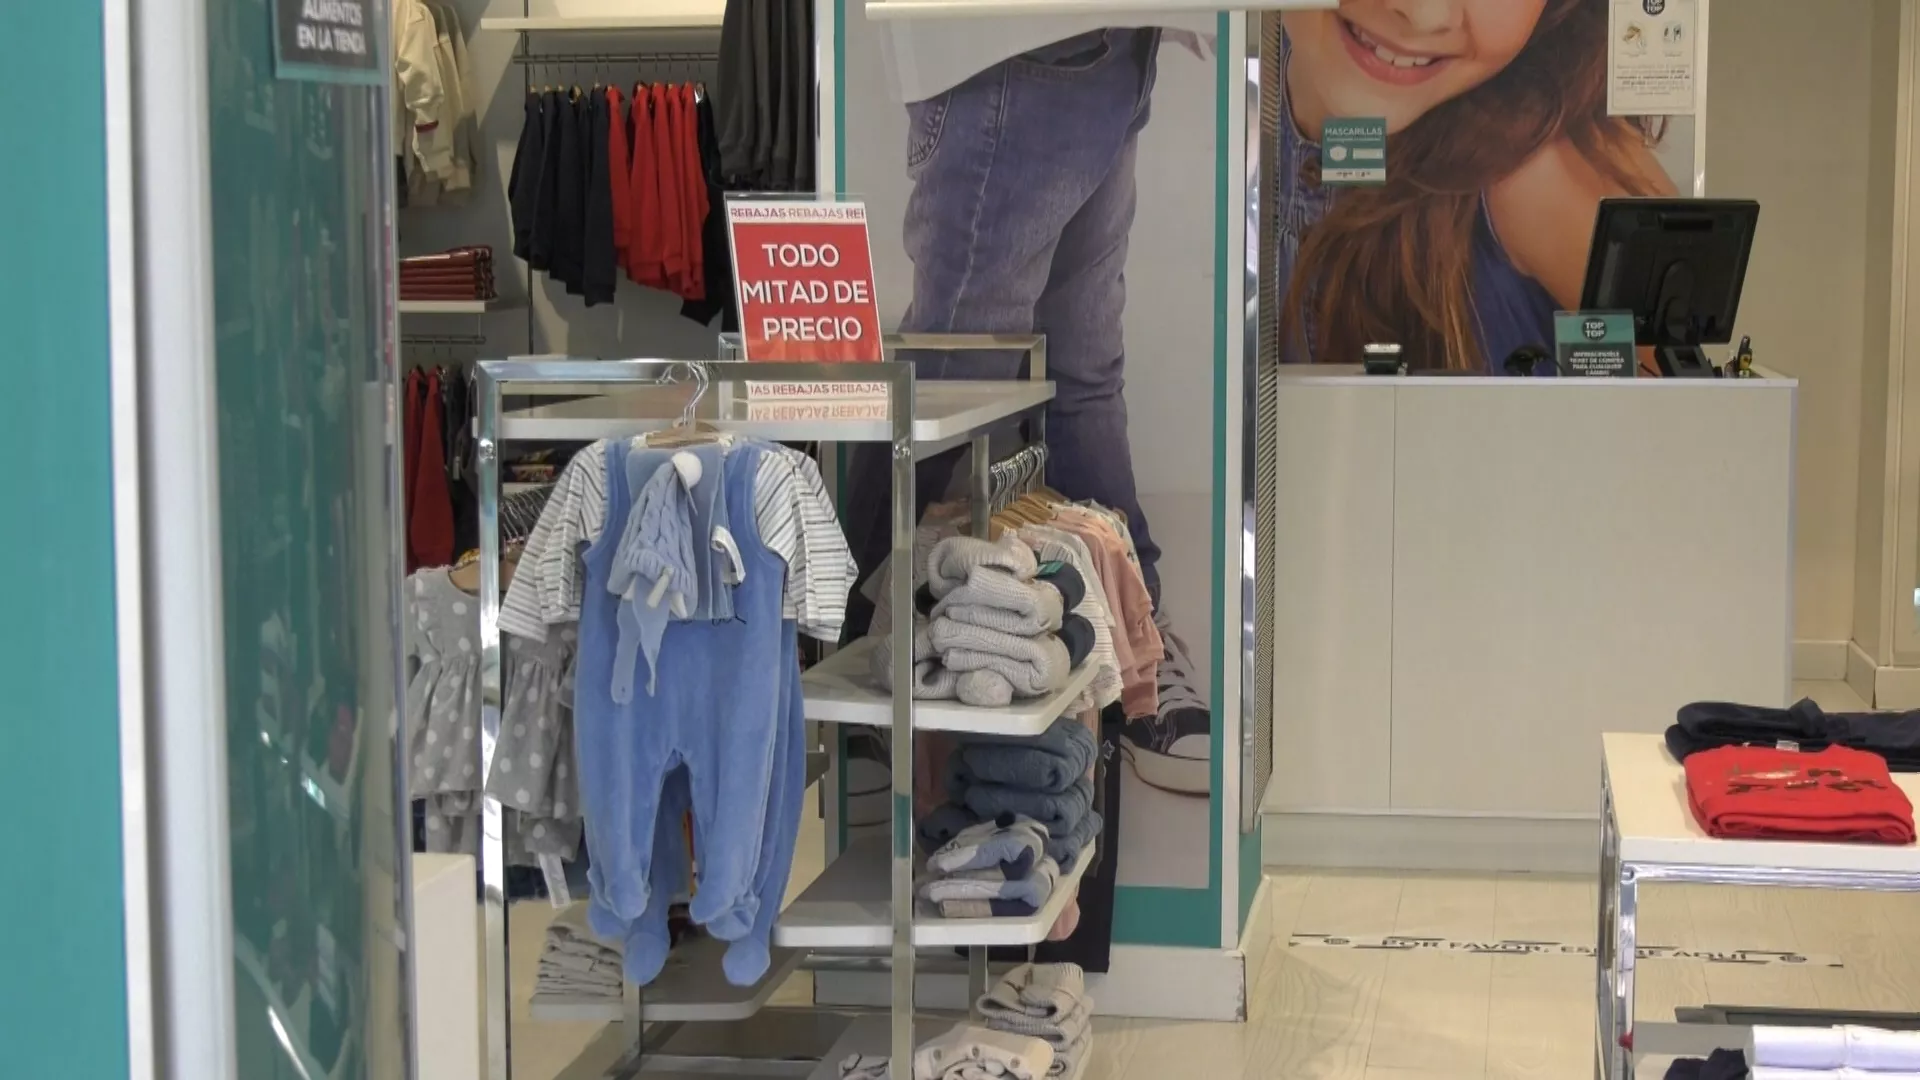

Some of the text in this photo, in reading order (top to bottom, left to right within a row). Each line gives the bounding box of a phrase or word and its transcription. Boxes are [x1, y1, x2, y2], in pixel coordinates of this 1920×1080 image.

[302, 0, 363, 26] ALIMENTOS
[297, 23, 367, 55] EN LA TIENDA
[1325, 127, 1383, 136] MASCARILLAS
[731, 207, 787, 219] REBAJAS
[788, 207, 844, 219] REBAJAS
[761, 244, 840, 267] TODO
[741, 279, 870, 304] MITAD DE
[762, 316, 862, 341] PRECIO
[773, 384, 829, 396] REBAJAS
[831, 382, 886, 394] REBAJAS
[1381, 938, 1439, 948] POR
